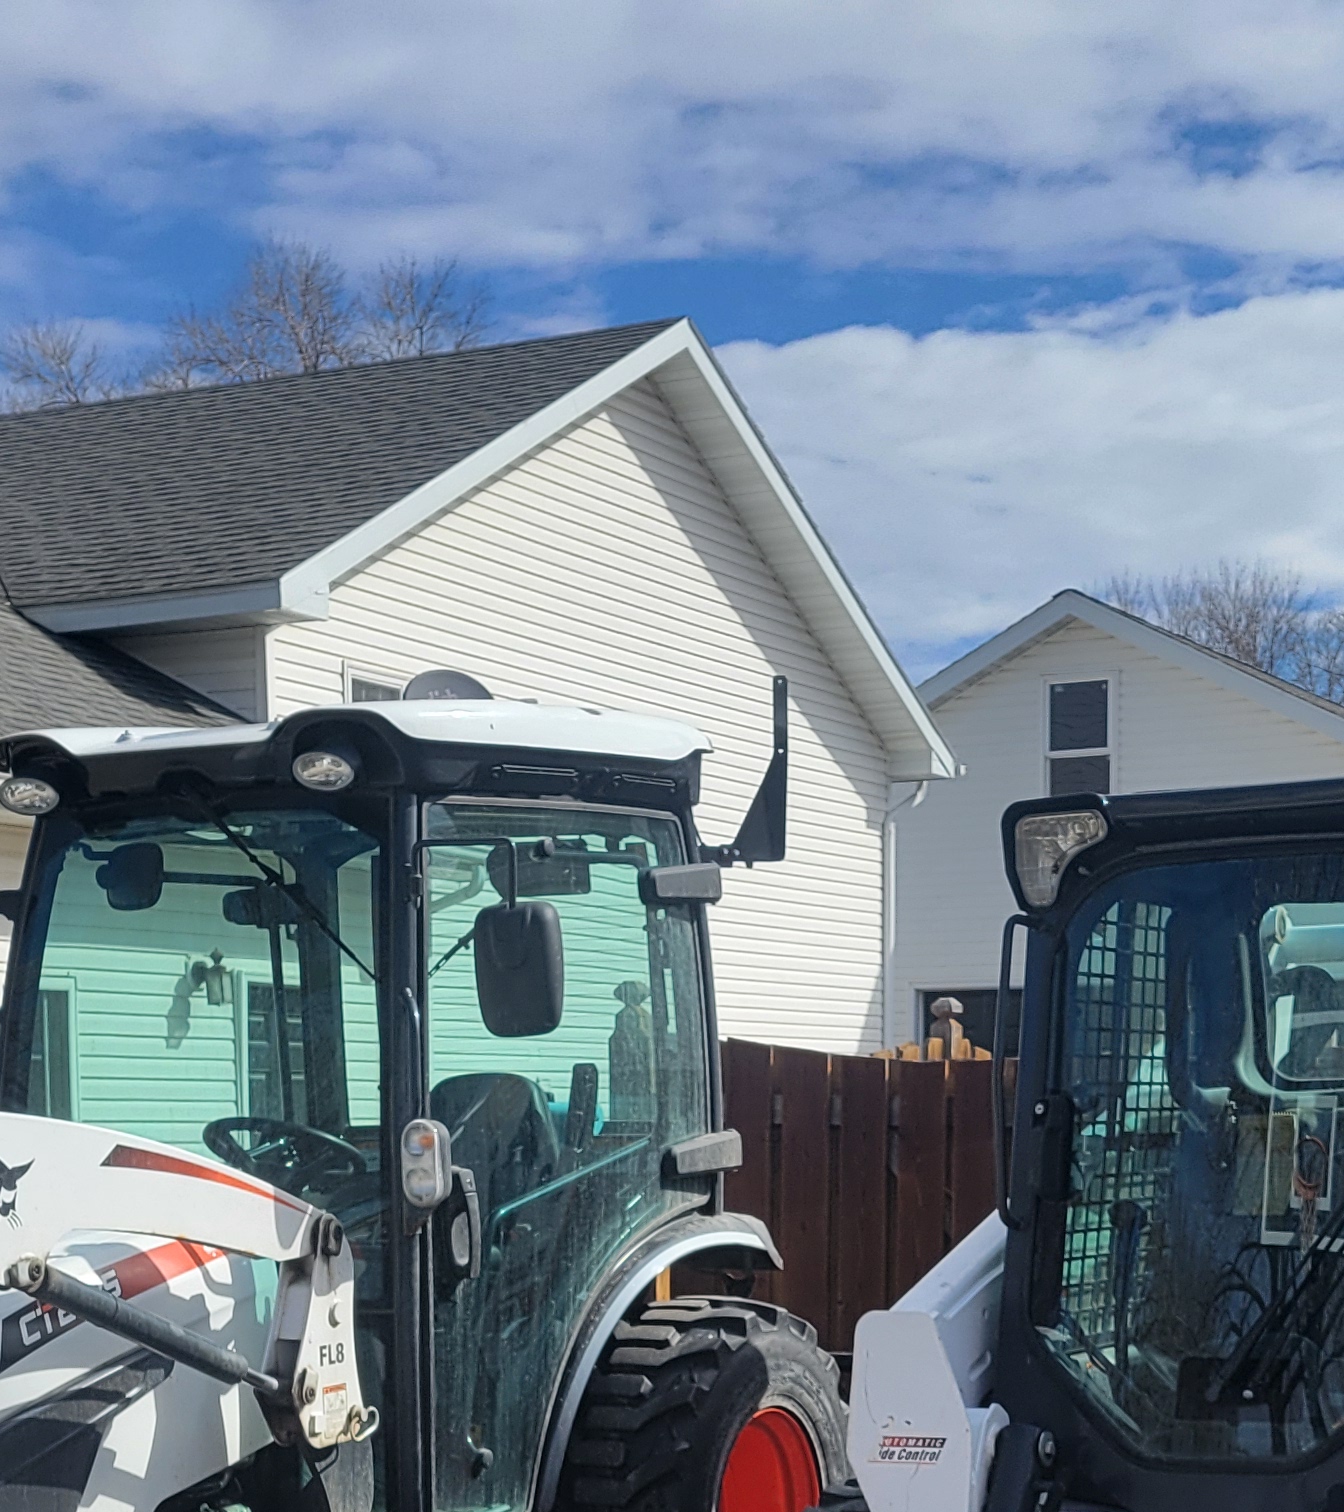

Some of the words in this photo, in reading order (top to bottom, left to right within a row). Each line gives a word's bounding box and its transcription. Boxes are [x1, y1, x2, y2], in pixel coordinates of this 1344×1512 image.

[319, 1342, 345, 1367] FL8
[883, 1437, 944, 1448] UTOMATIC
[878, 1448, 896, 1460] ide
[897, 1448, 942, 1462] Control
